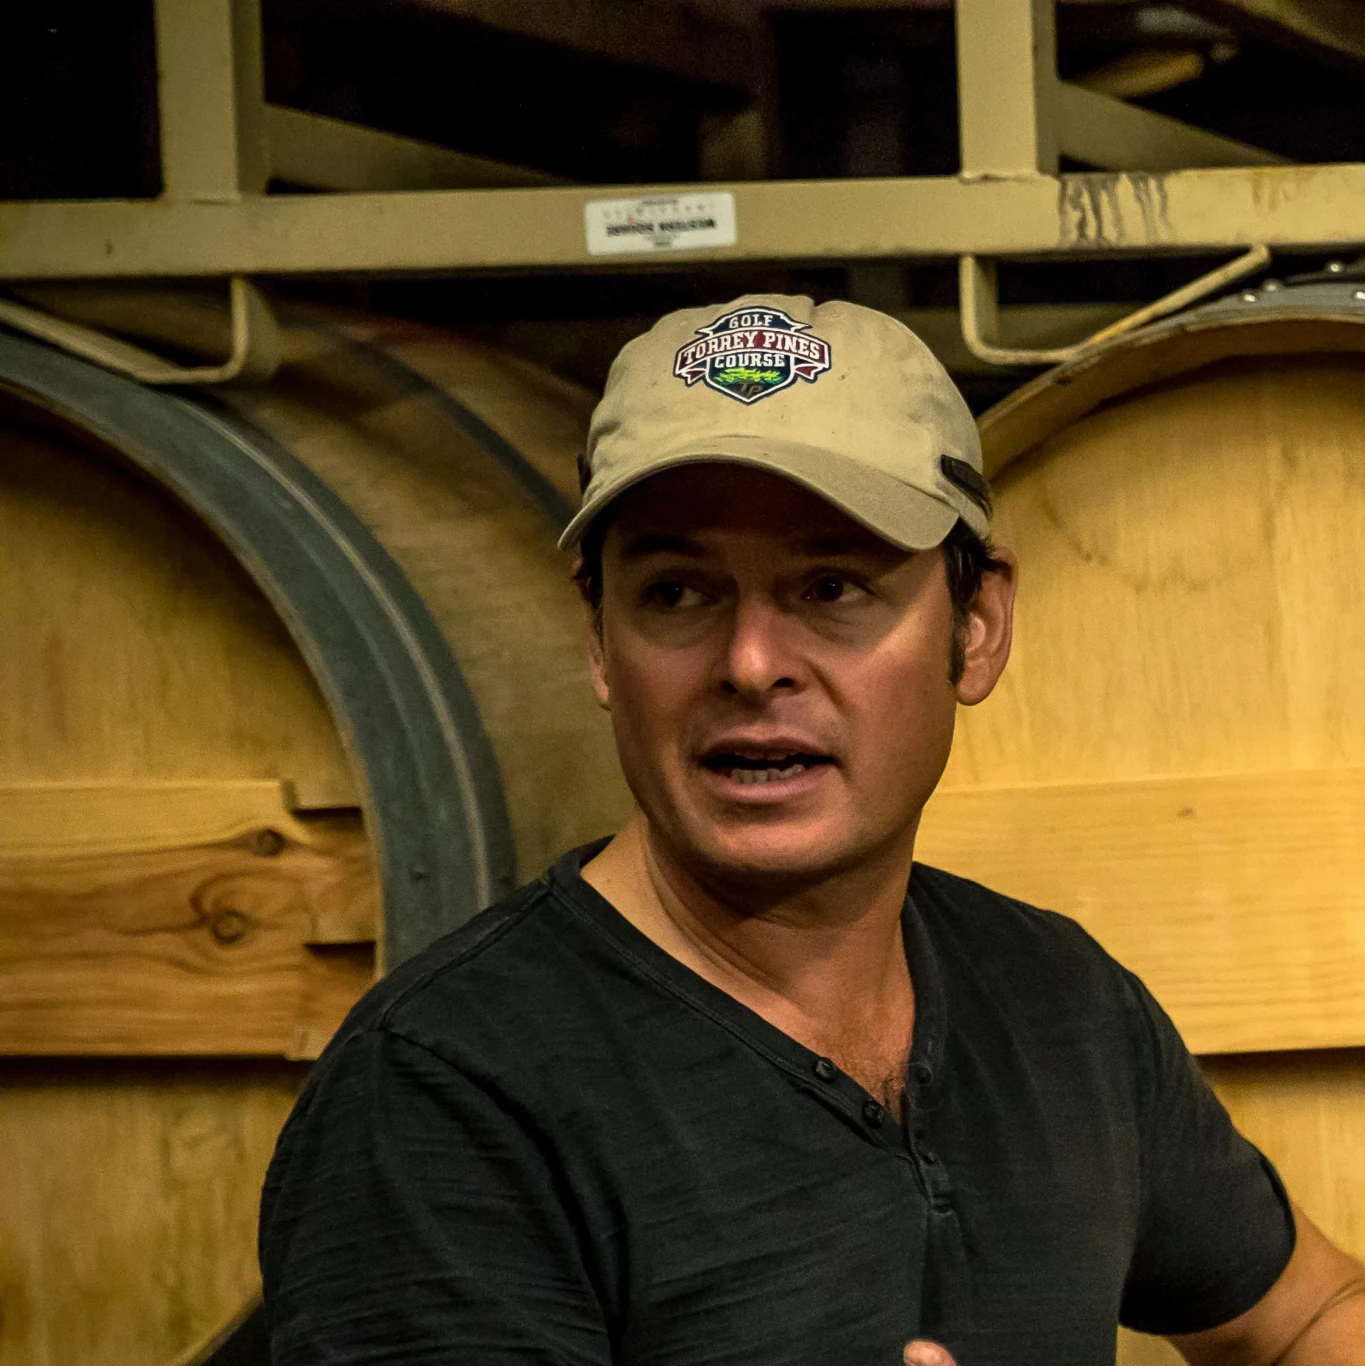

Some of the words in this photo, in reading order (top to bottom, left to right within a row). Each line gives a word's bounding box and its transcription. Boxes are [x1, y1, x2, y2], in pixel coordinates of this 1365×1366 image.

[729, 313, 774, 329] GOLF
[683, 330, 759, 365] TORREY
[762, 331, 820, 360] PINES
[714, 352, 786, 369] COURSE
